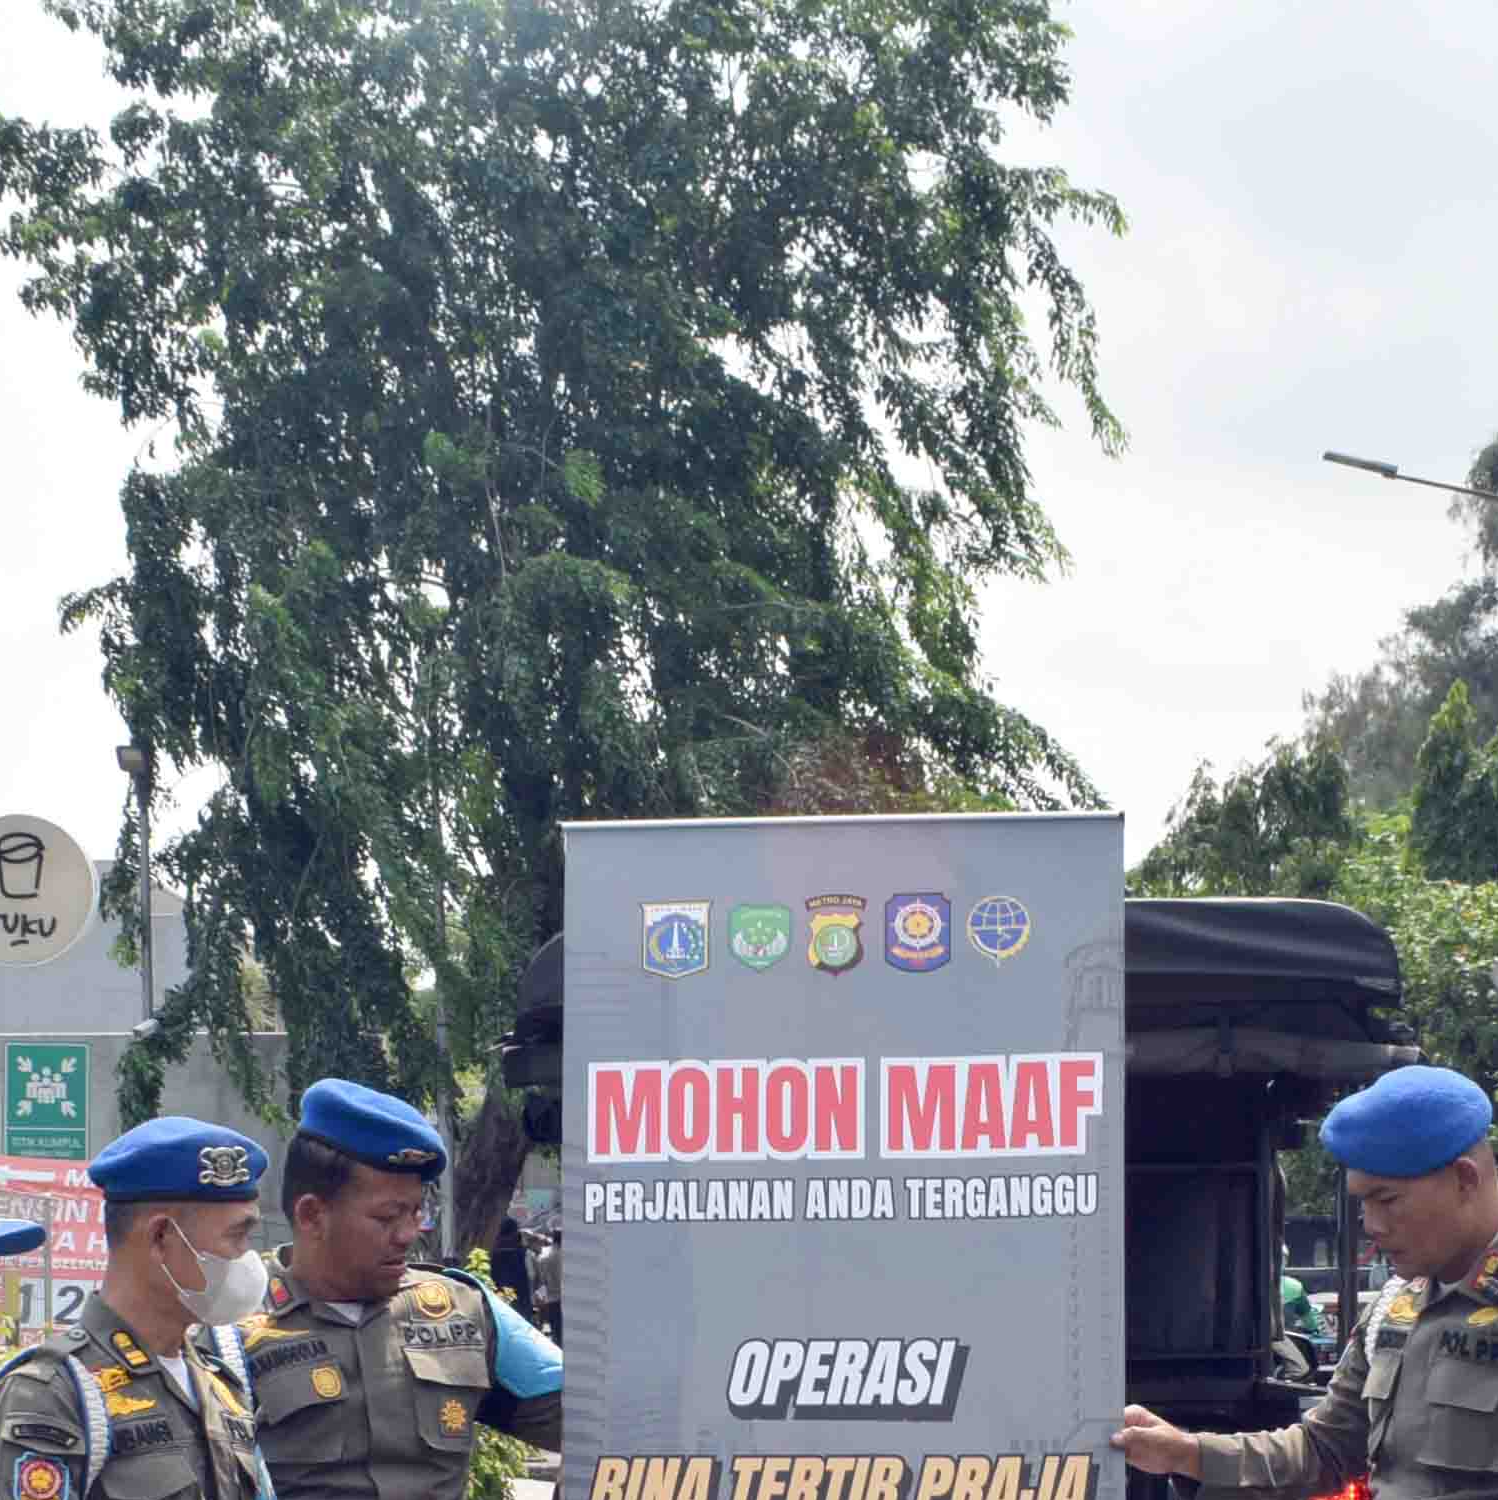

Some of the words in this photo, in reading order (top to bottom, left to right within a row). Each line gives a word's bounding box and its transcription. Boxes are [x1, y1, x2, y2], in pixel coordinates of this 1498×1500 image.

[591, 1060, 862, 1159] MOHON
[884, 1056, 1100, 1155] MAAF
[584, 1178, 794, 1222] PERJALANAN
[805, 1176, 894, 1220] ANDA
[905, 1173, 1099, 1218] TERGANGGU
[727, 1338, 959, 1408] OPERASI
